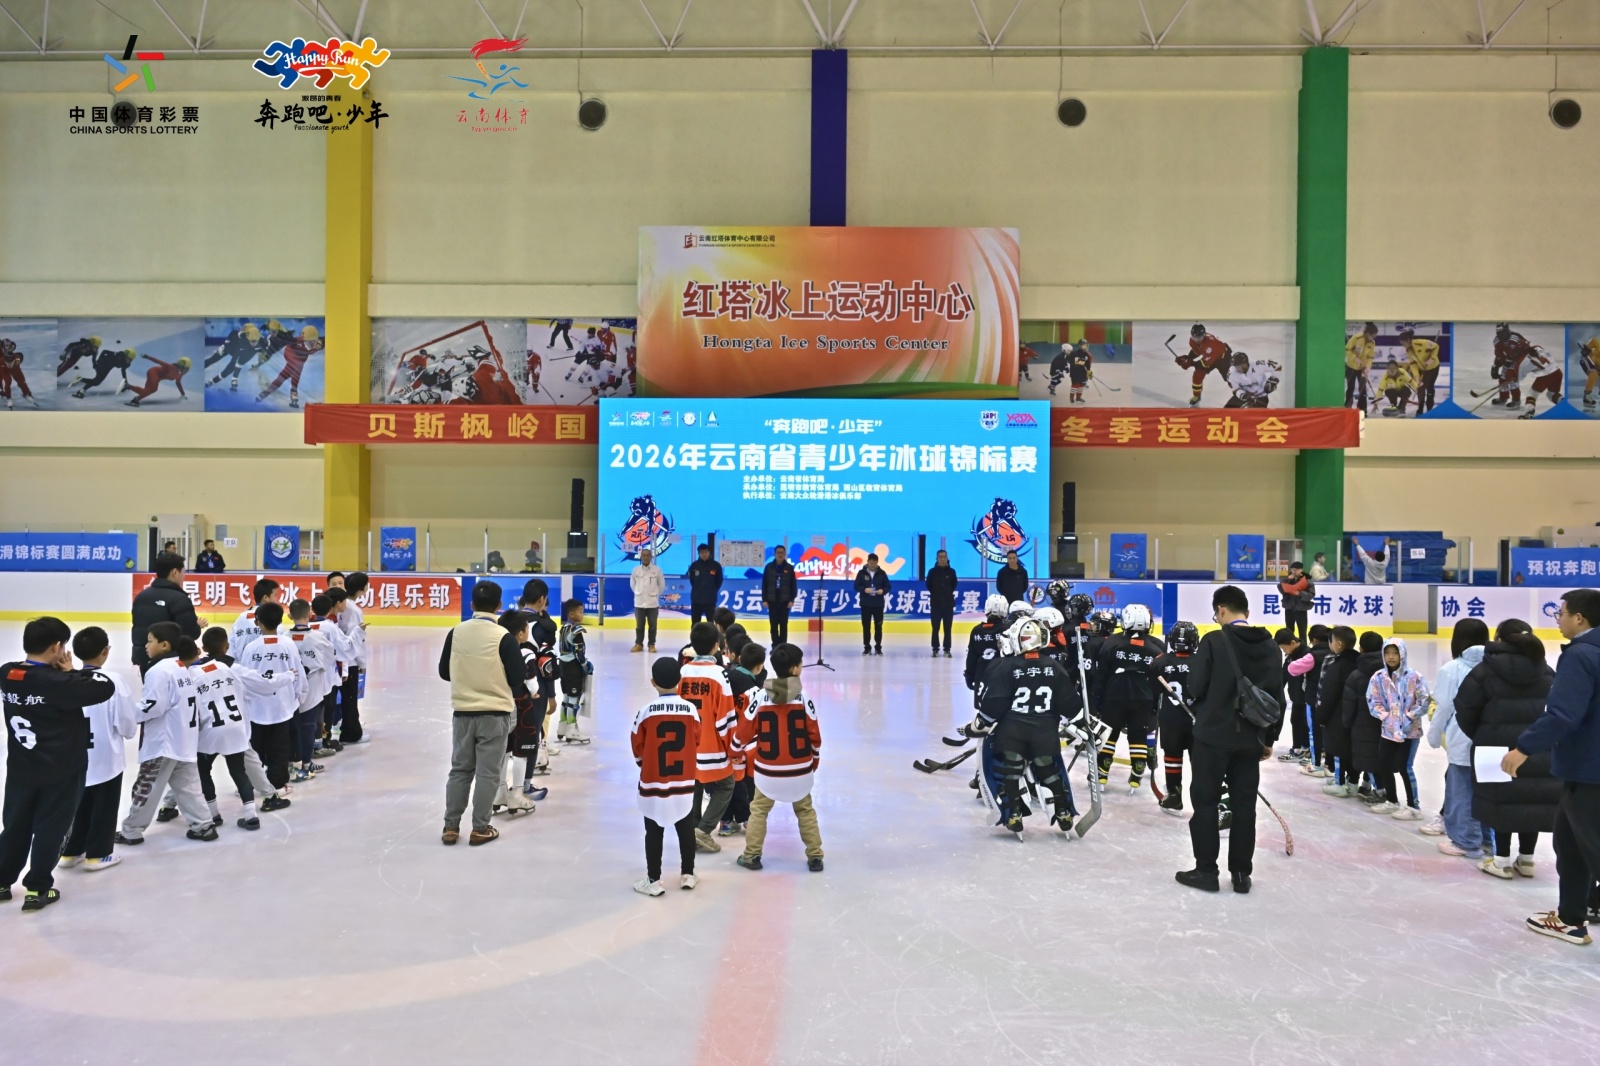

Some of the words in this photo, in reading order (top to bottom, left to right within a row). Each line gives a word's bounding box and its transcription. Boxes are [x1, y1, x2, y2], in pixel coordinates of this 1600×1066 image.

[699, 234, 776, 242] 云南红塔体育中心有限公司
[682, 280, 975, 322] 红塔冰上运动中心
[702, 334, 773, 353] Hongta
[780, 334, 808, 350] Ice
[816, 334, 878, 353] Sports
[885, 335, 949, 351] Center
[367, 413, 586, 440] 贝斯枫岭国
[1060, 416, 1289, 443] 冬季运动会
[609, 443, 1038, 472] 2026年云南省青少年冰球锦标赛
[0, 544, 122, 561] 滑锦标赛圆满成功
[791, 556, 834, 576] appy
[1527, 560, 1600, 576] 预祝奔跑
[182, 580, 450, 610] 昆明飞冰上动俱乐部
[142, 699, 157, 714] 7
[188, 696, 197, 728] 7
[208, 694, 242, 728] 15
[1010, 686, 1053, 714] 23
[9, 715, 38, 750] 6
[757, 708, 812, 761] 98
[656, 720, 687, 777] 2
[1088, 752, 1099, 803] BAUER
